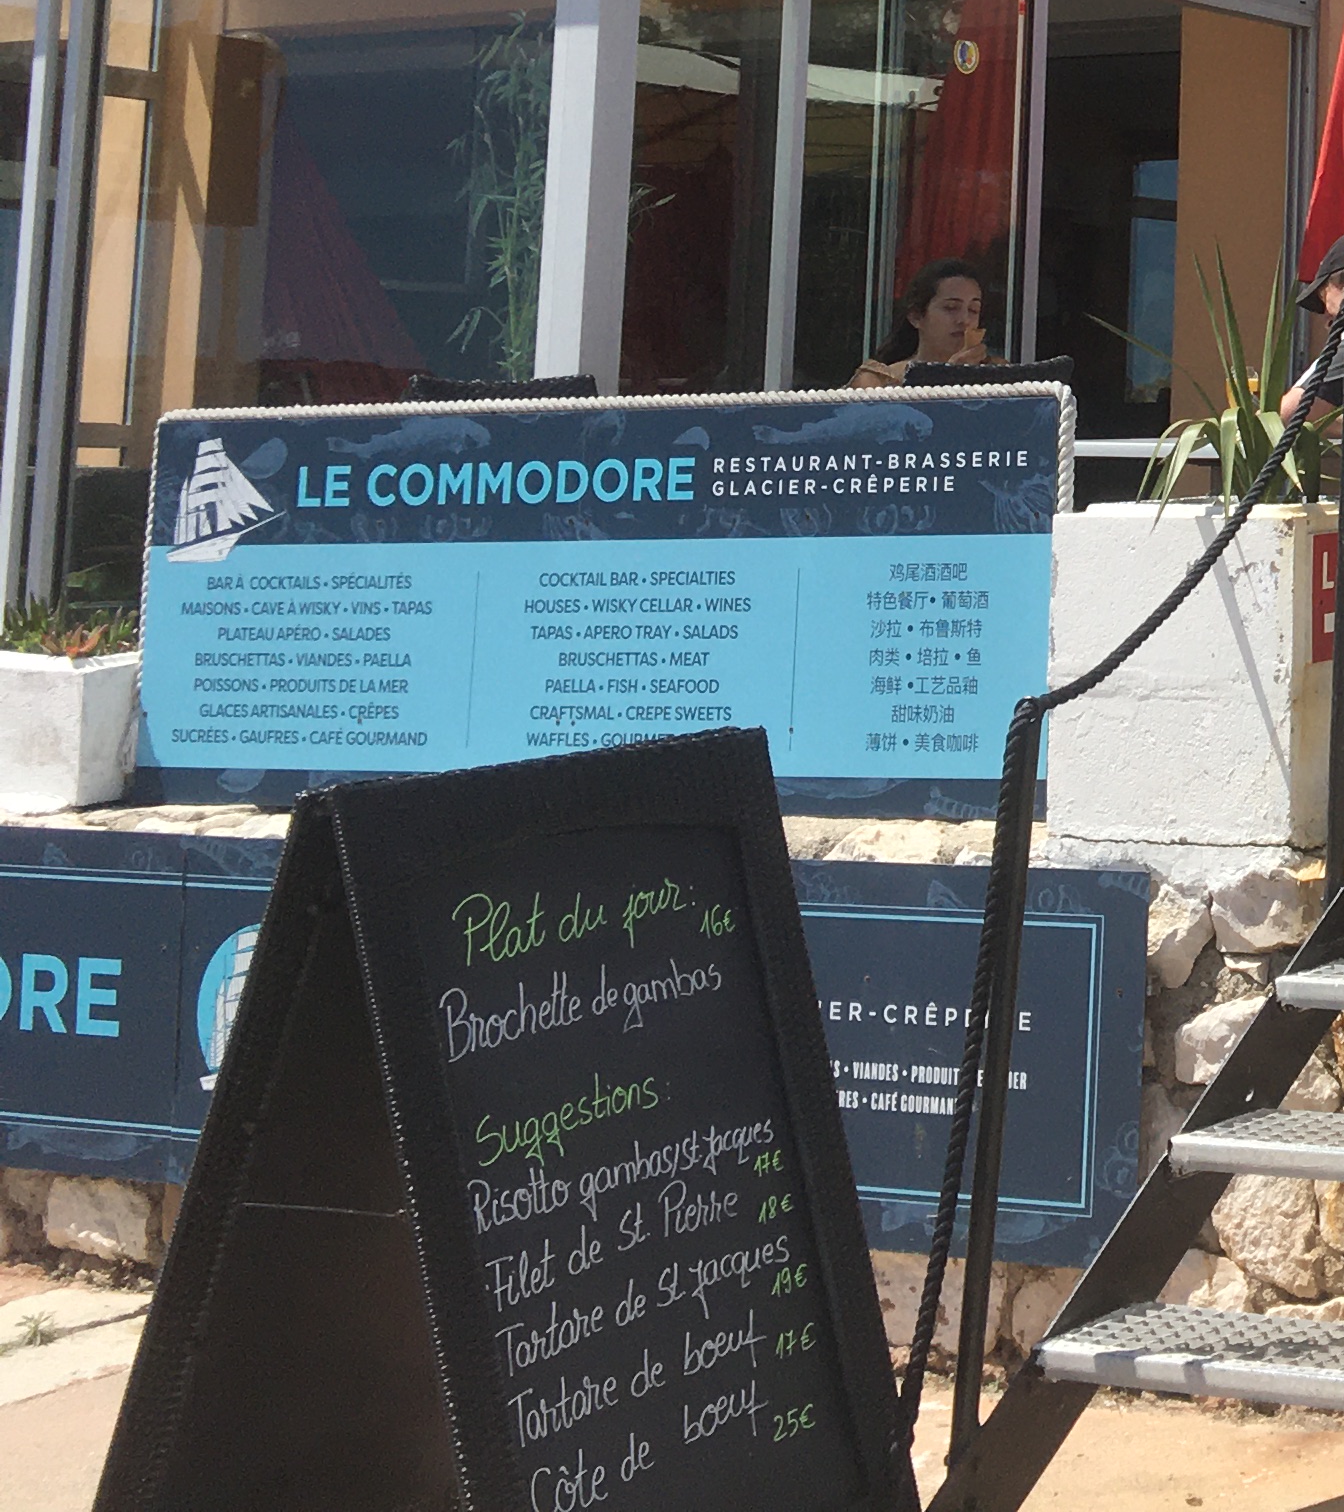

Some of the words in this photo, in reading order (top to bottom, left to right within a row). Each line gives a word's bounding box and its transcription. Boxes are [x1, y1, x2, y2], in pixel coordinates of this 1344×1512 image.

[713, 450, 1030, 474] RESTAURANT-BRASSERIE
[297, 465, 350, 507] LE
[366, 457, 695, 506] COMMODORE
[712, 472, 956, 498] GLACIER-CRÊPERIE
[207, 576, 233, 590] BAR
[250, 575, 321, 590] COCKTAILS
[331, 572, 412, 590] SPÉCIALITÉS
[539, 572, 608, 588] COCKTAIL
[610, 571, 639, 586] BAR
[650, 570, 736, 586] SPECIALTIES
[889, 562, 968, 582] 鸡尾酒酒吧
[181, 602, 241, 616] MAISONS
[251, 602, 285, 615] CAVE
[299, 602, 341, 615] WISKY
[351, 602, 381, 615] VINS
[392, 601, 432, 615] TAPAS
[524, 599, 581, 614] HOUSES
[592, 598, 637, 613] WISKY
[639, 598, 693, 613] CELLAR
[705, 597, 752, 613] WINES
[866, 591, 927, 611] 特色餐厅
[942, 591, 989, 610] 葡萄酒
[218, 627, 274, 641] PLATEAU
[276, 623, 321, 641] APÉRO
[332, 627, 391, 641] SALADES
[531, 625, 573, 640] TAPAS
[583, 625, 632, 640] APERO
[635, 625, 672, 639] TRAY
[682, 625, 738, 640] SALADS
[870, 620, 902, 638] 沙拉
[919, 619, 982, 638] 布鲁斯特
[194, 653, 285, 667] BRUSCHETTAS
[296, 653, 352, 667] VIANDES
[363, 653, 412, 667] PAELLA
[558, 652, 658, 667] BRUSCHETTAS
[669, 652, 709, 667] MEAT
[869, 648, 900, 666] 肉类
[917, 648, 949, 666] 培拉
[966, 648, 982, 666] 鱼
[194, 678, 258, 693] POISSONS
[270, 679, 336, 693] PRODUITS
[339, 679, 357, 693] DE
[359, 679, 377, 693] LA
[378, 679, 409, 694] MER
[545, 679, 596, 694] PAELLA
[607, 679, 638, 694] FISH
[650, 679, 720, 694] SEAFOOD
[870, 676, 902, 695] 海鲜
[199, 704, 249, 718] GLACES
[250, 704, 338, 719] ARTISANALES
[348, 701, 400, 720] CRÊPES
[530, 706, 615, 721] CRAFTSMAL
[625, 706, 671, 721] CREPE
[674, 706, 732, 721] SWEETS
[891, 704, 955, 723] 甜味奶油
[171, 726, 229, 744] SUCRÉES
[239, 730, 299, 744] GAUFRES
[309, 726, 344, 745] CAFÉ
[345, 731, 428, 746] GOURMAND
[526, 732, 590, 747] WAFFLES
[865, 733, 897, 752] 薄饼
[914, 733, 979, 752] 美食咖啡
[453, 892, 546, 966] Plat
[558, 892, 607, 943] du
[700, 905, 736, 939] 16€
[440, 970, 583, 1063] Brochette
[853, 1061, 898, 1082] VIANDES
[911, 1065, 960, 1086] PRODUIT
[871, 1092, 897, 1111] CAFÉ
[900, 1094, 960, 1115] GOURMAN
[753, 1149, 784, 1177] 17€
[468, 1168, 569, 1234] Risotto
[758, 1193, 793, 1224] 18€
[485, 1239, 556, 1311] Filet
[568, 1225, 601, 1275] de
[658, 1180, 739, 1238] Pierre
[771, 1264, 808, 1298] 19€
[496, 1302, 603, 1376] Tartare
[615, 1278, 647, 1326] de
[775, 1323, 817, 1359] 17€
[508, 1377, 617, 1448] Tartare
[631, 1349, 666, 1398] de
[773, 1404, 816, 1442] 25€
[621, 1433, 655, 1483] de
